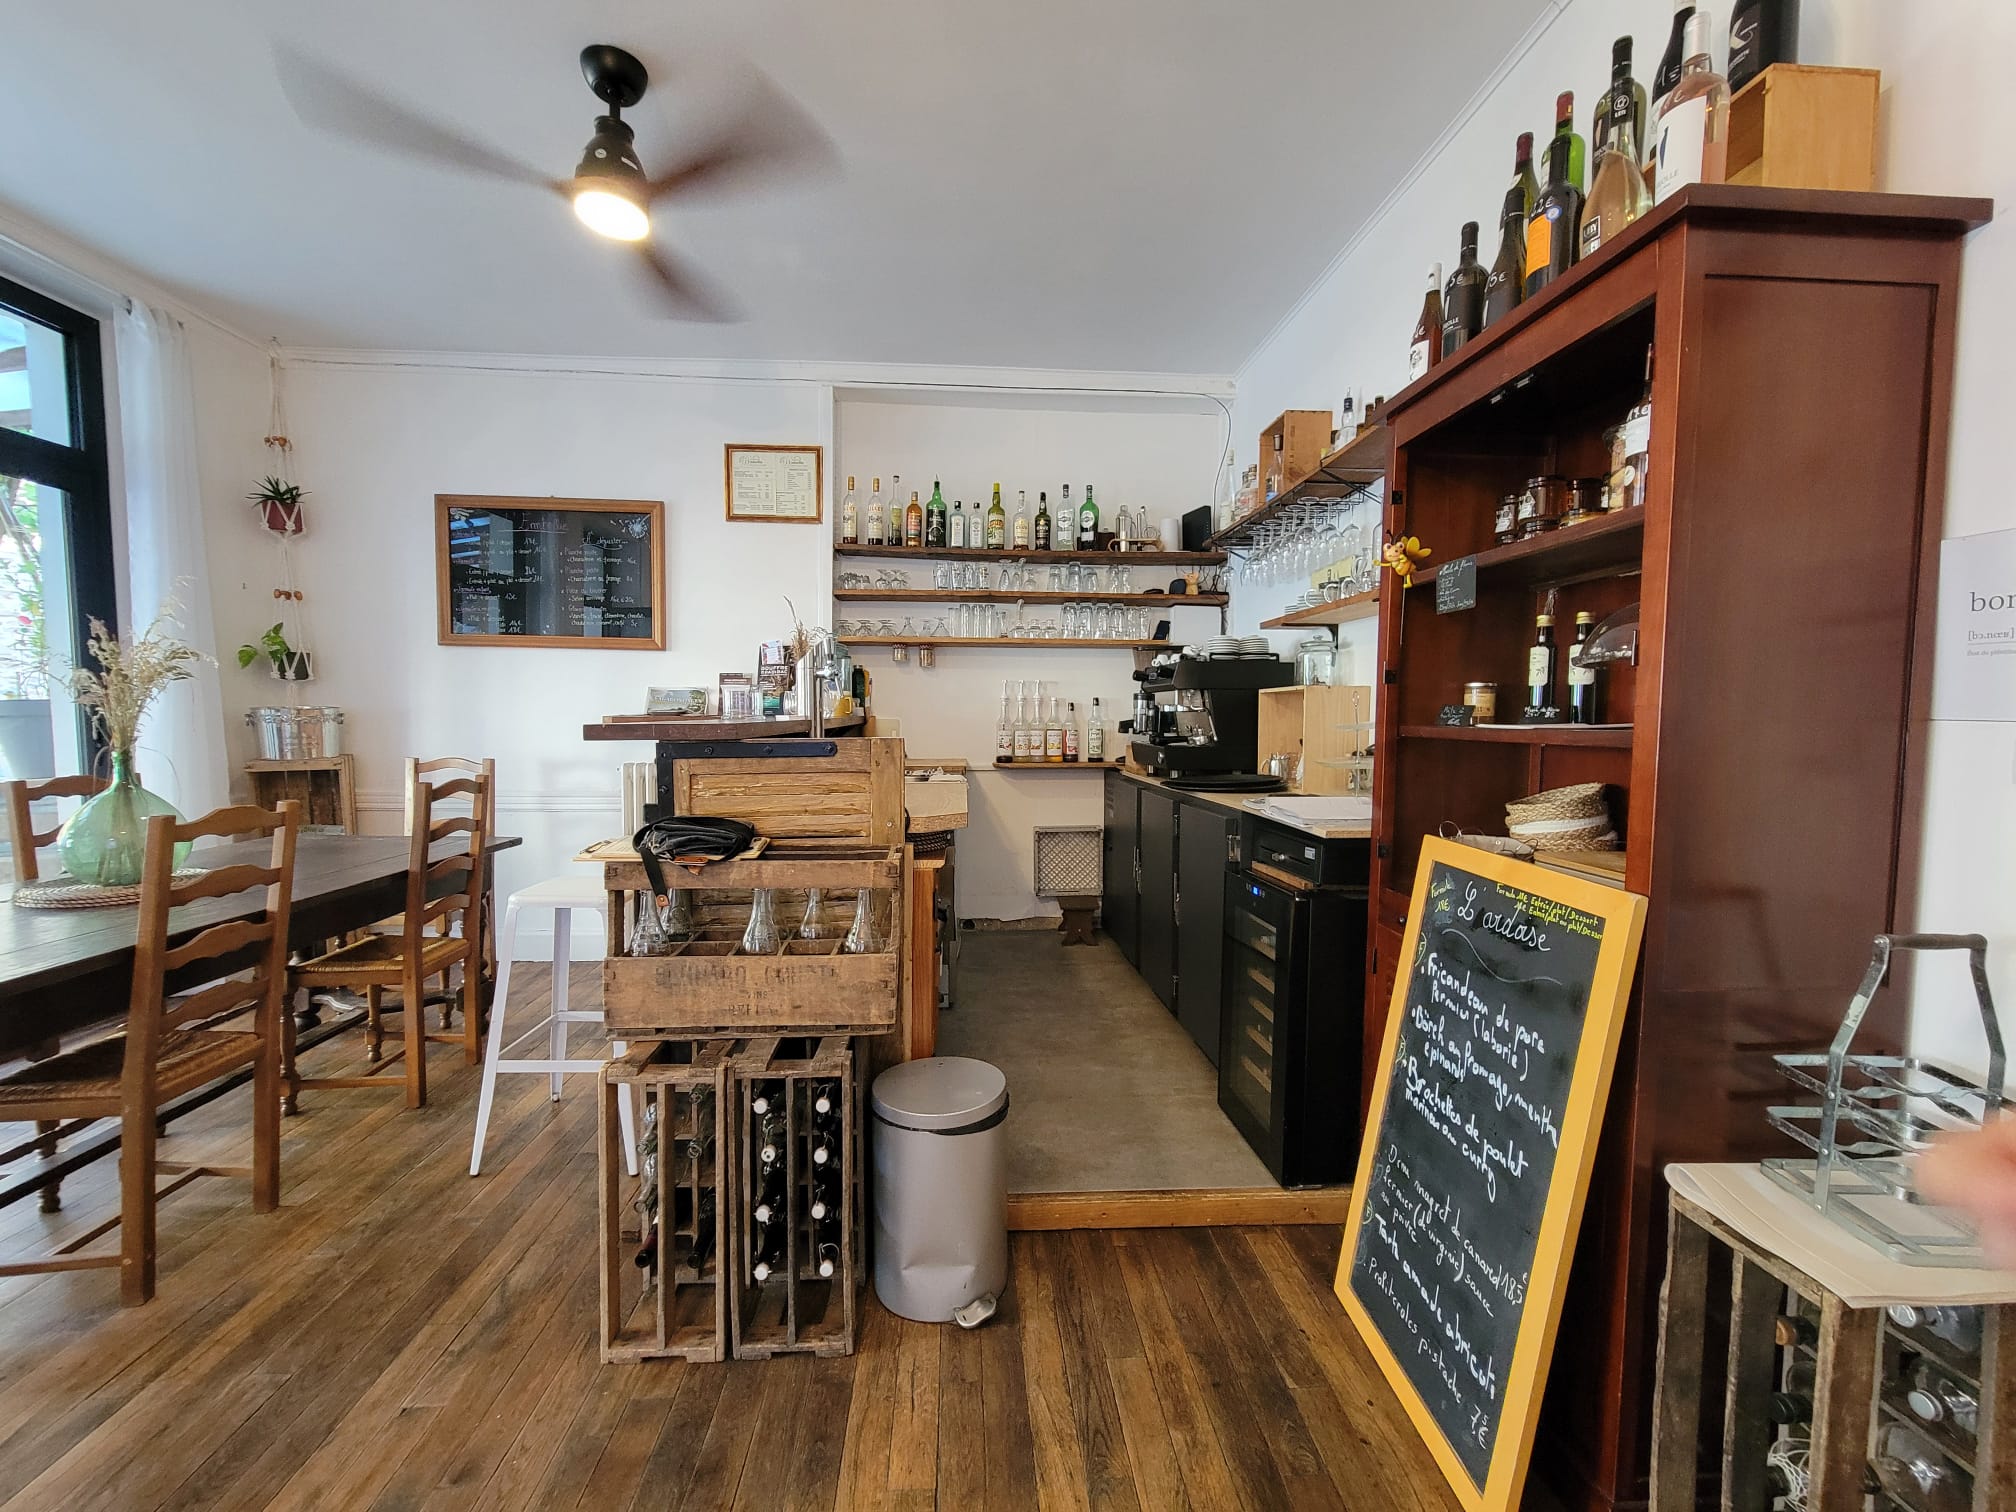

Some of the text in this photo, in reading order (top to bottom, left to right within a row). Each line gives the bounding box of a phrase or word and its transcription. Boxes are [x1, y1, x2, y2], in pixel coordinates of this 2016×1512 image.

[1496, 1003, 1510, 1032] de
[1406, 1056, 1529, 1179] Brochettes de poulet
[1462, 1143, 1497, 1204] curry
[1392, 1207, 1417, 1243] poivre
[1413, 1180, 1451, 1225] magret
[1451, 1207, 1462, 1242] de
[1463, 1239, 1502, 1291] canard
[1464, 1273, 1495, 1318] sauce
[1418, 1337, 1463, 1404] pistache
